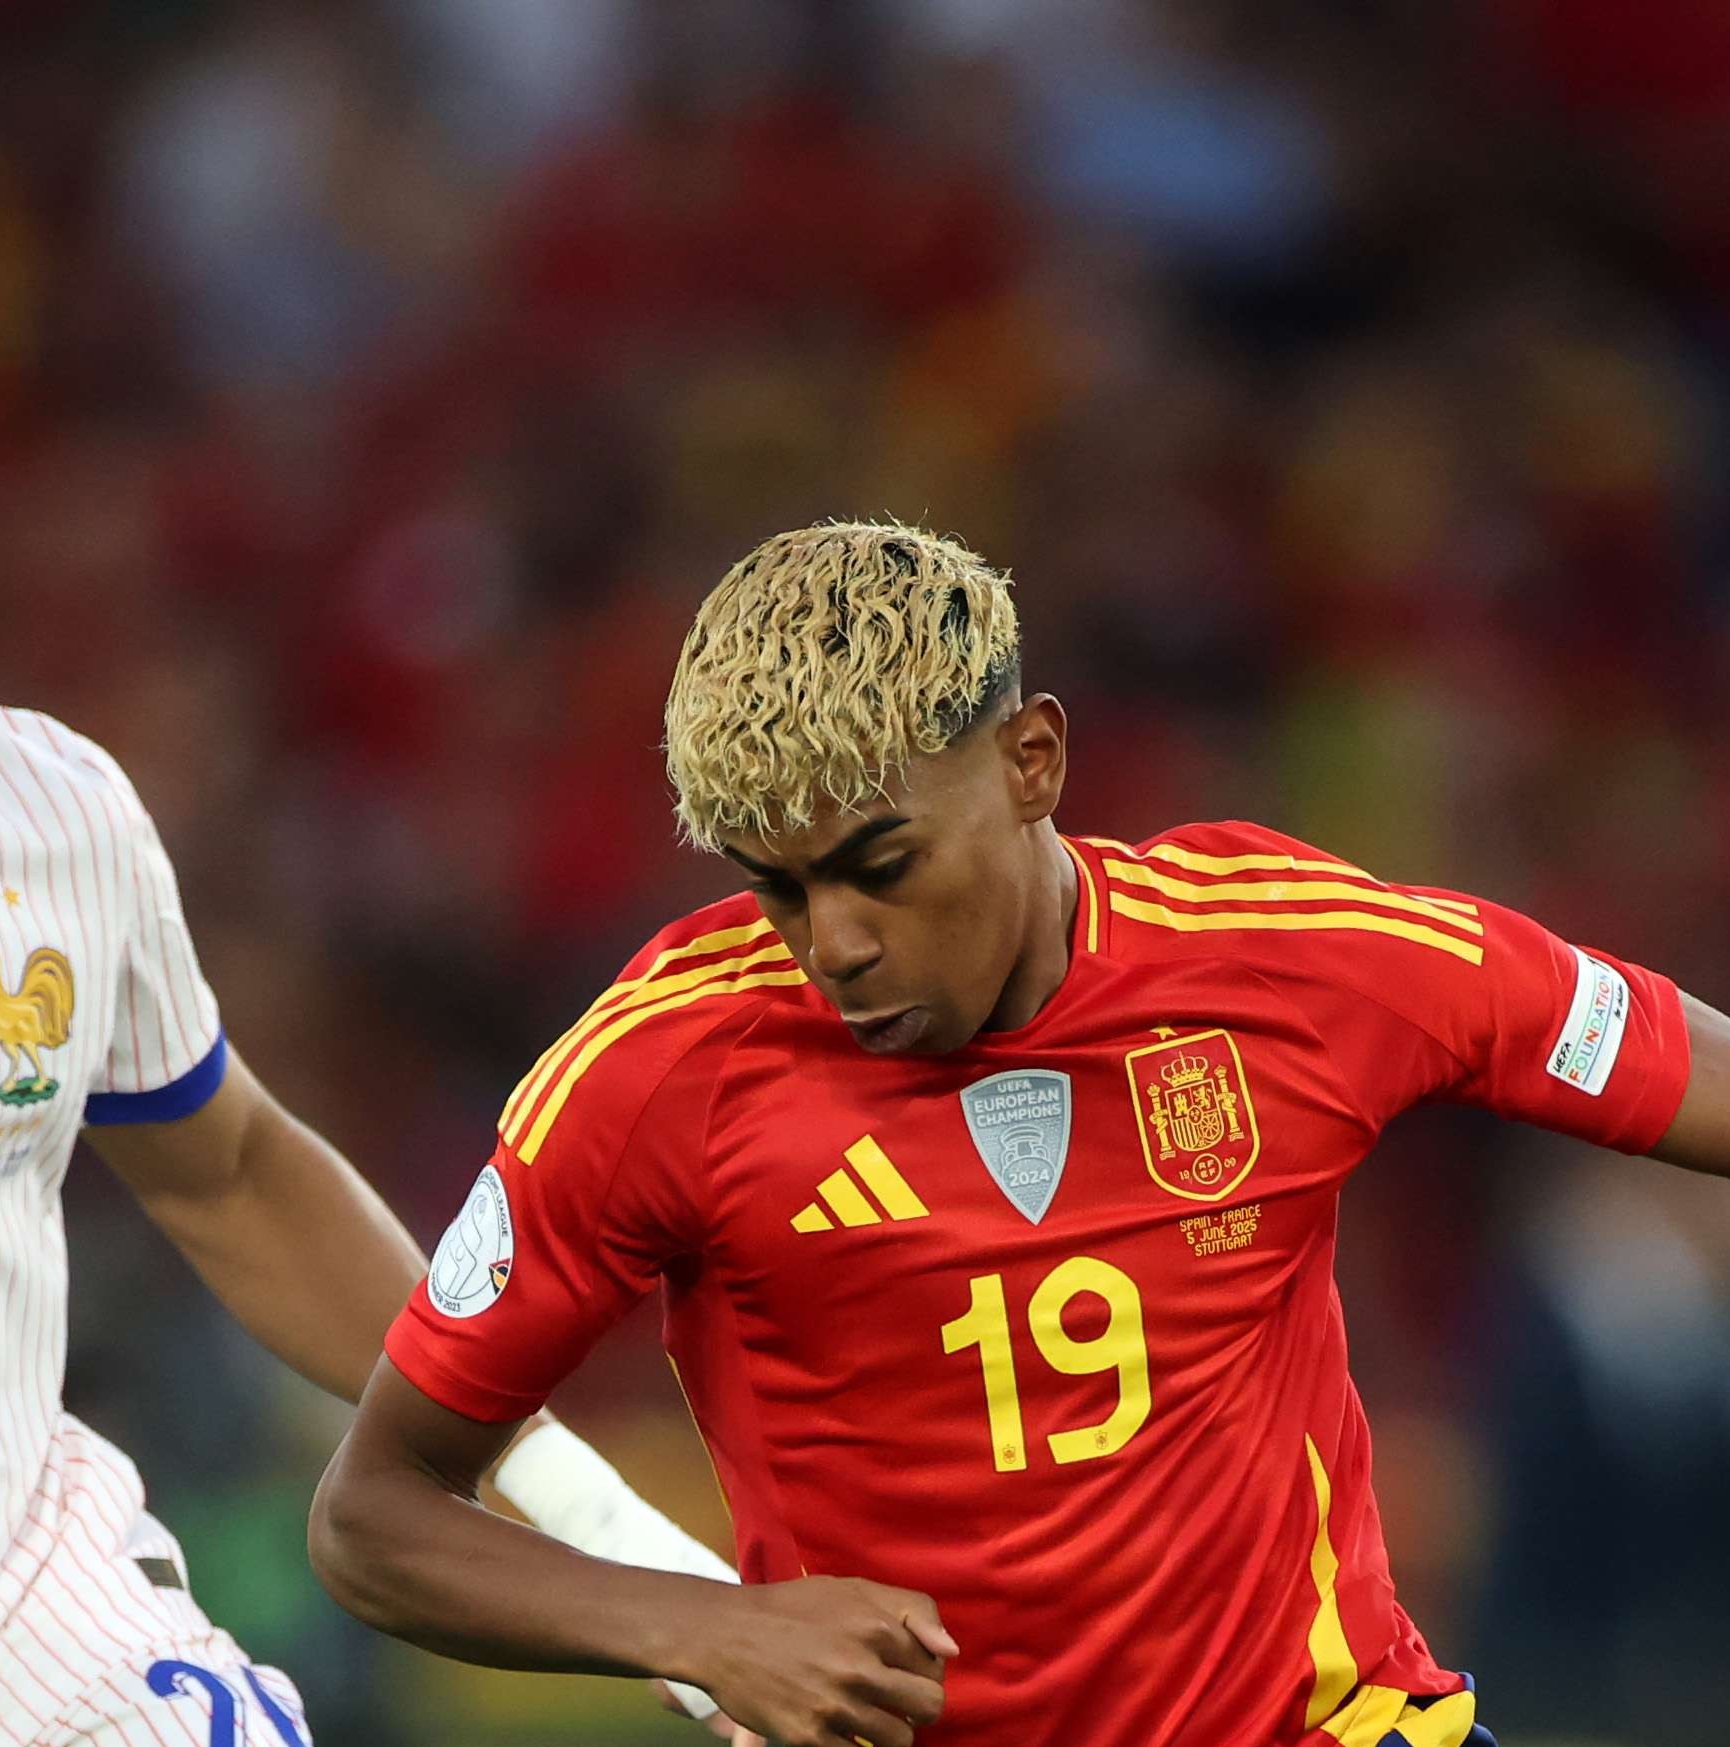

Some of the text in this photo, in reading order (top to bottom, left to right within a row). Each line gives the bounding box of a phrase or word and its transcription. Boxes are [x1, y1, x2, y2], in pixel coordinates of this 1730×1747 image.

[997, 1078, 1032, 1093] UEFA
[974, 1088, 1060, 1114] EUROPEAN
[976, 1103, 1062, 1128] CHAMPIONS
[1008, 1168, 1051, 1188] 2024
[1179, 1215, 1212, 1233] SPAIN
[1221, 1203, 1262, 1224] FRANCE
[1186, 1218, 1258, 1245] 5 JUNE 2025
[1194, 1233, 1253, 1257] STUTTGART
[941, 1256, 1152, 1472] 19
